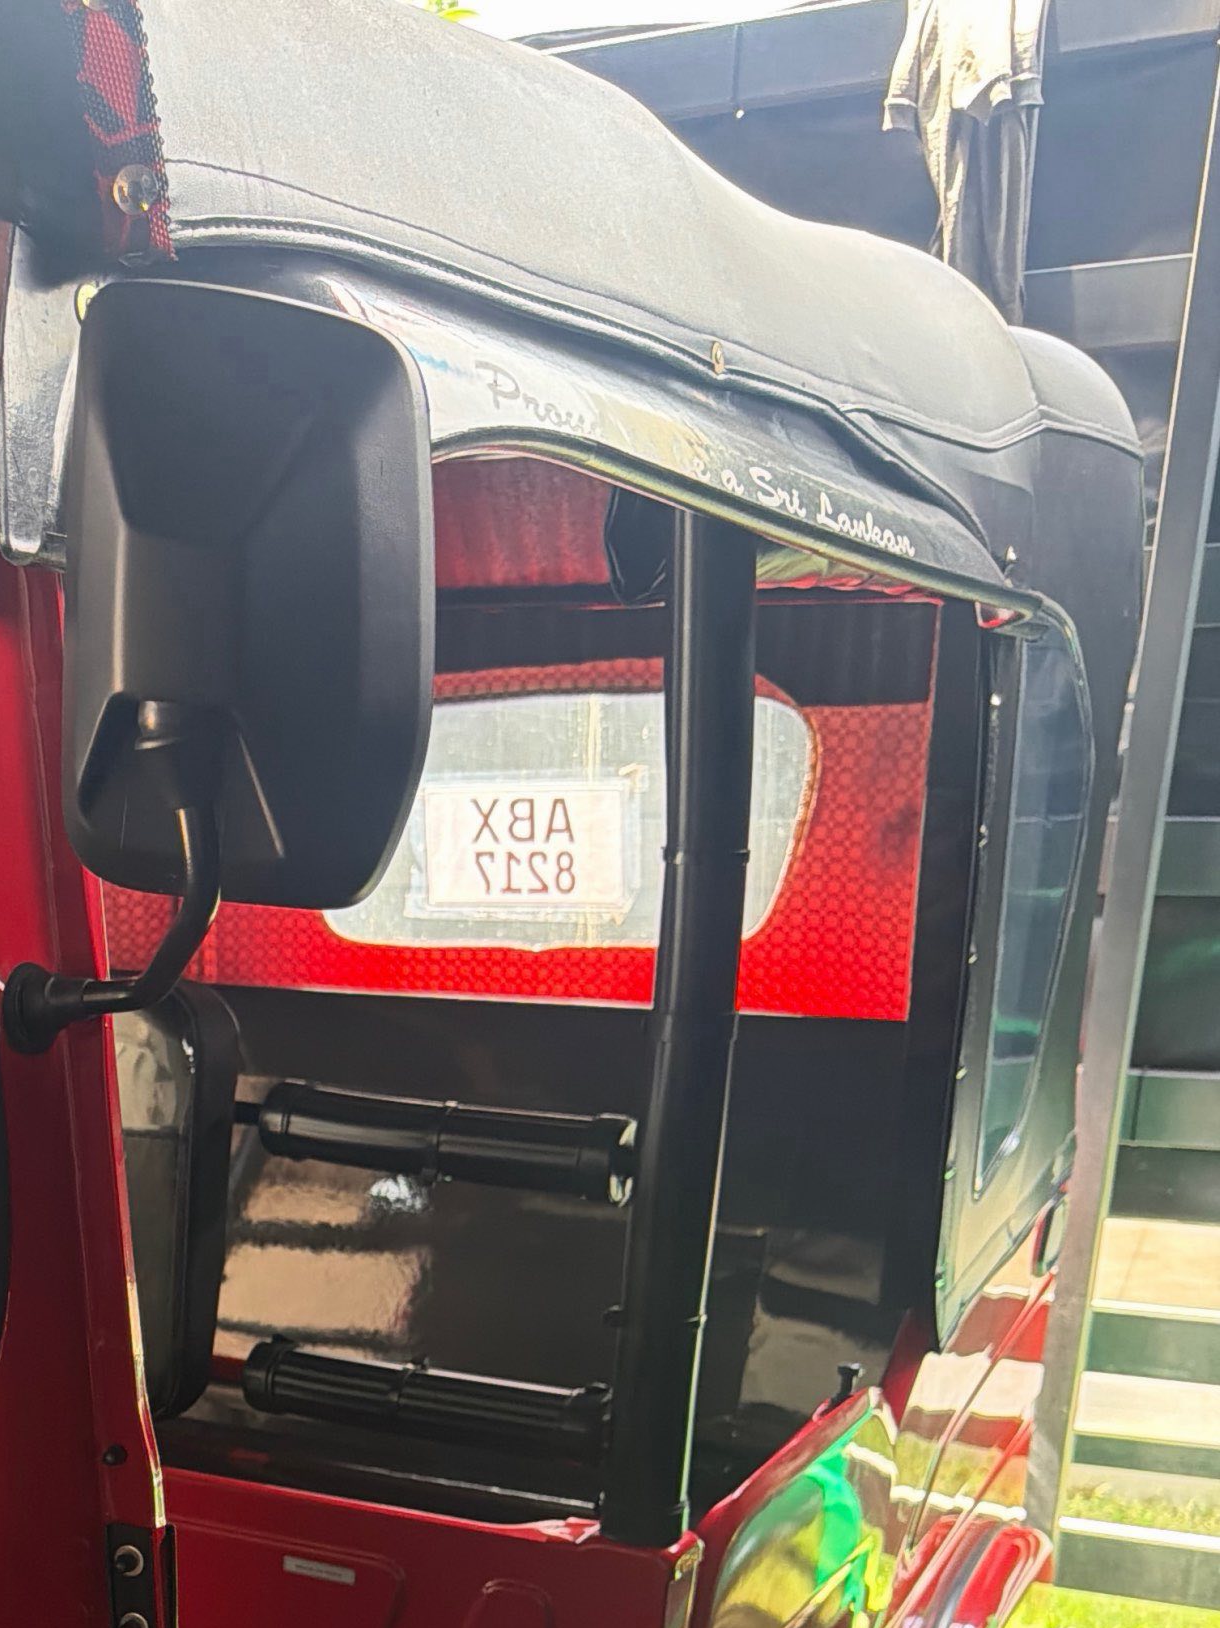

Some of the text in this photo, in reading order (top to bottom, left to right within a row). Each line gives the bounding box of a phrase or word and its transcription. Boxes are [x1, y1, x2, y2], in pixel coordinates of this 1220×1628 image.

[474, 360, 603, 437] Prou
[720, 469, 745, 497] a
[748, 465, 807, 520] Sri
[815, 490, 916, 559] Lankan
